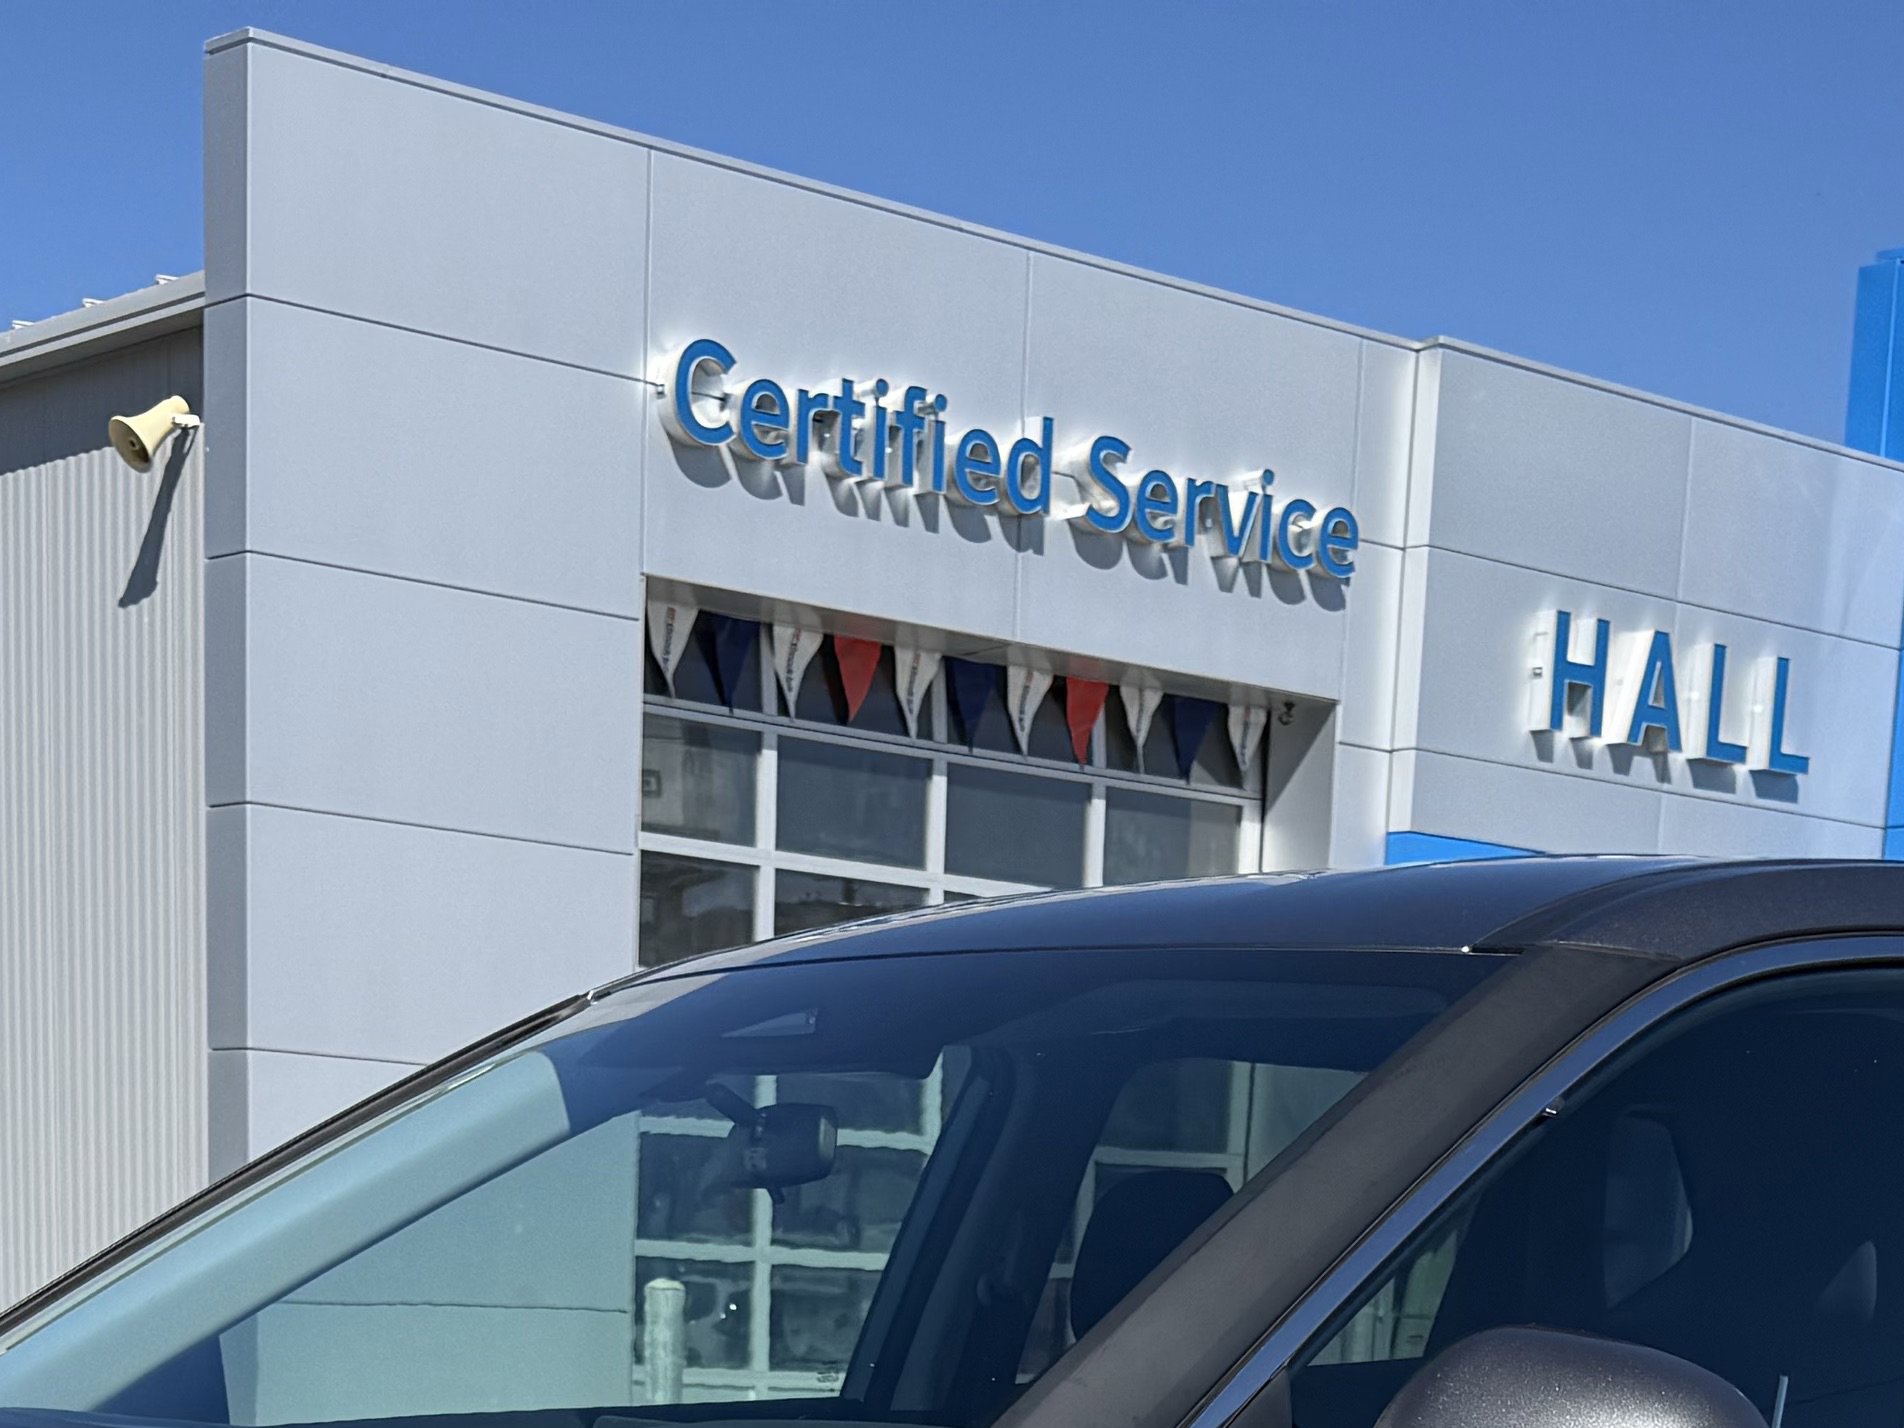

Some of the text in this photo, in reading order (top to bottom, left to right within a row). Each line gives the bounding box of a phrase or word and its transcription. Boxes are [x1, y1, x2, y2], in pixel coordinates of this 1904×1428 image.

[674, 337, 1361, 580] Certified Service
[1549, 608, 1811, 775] HALL
